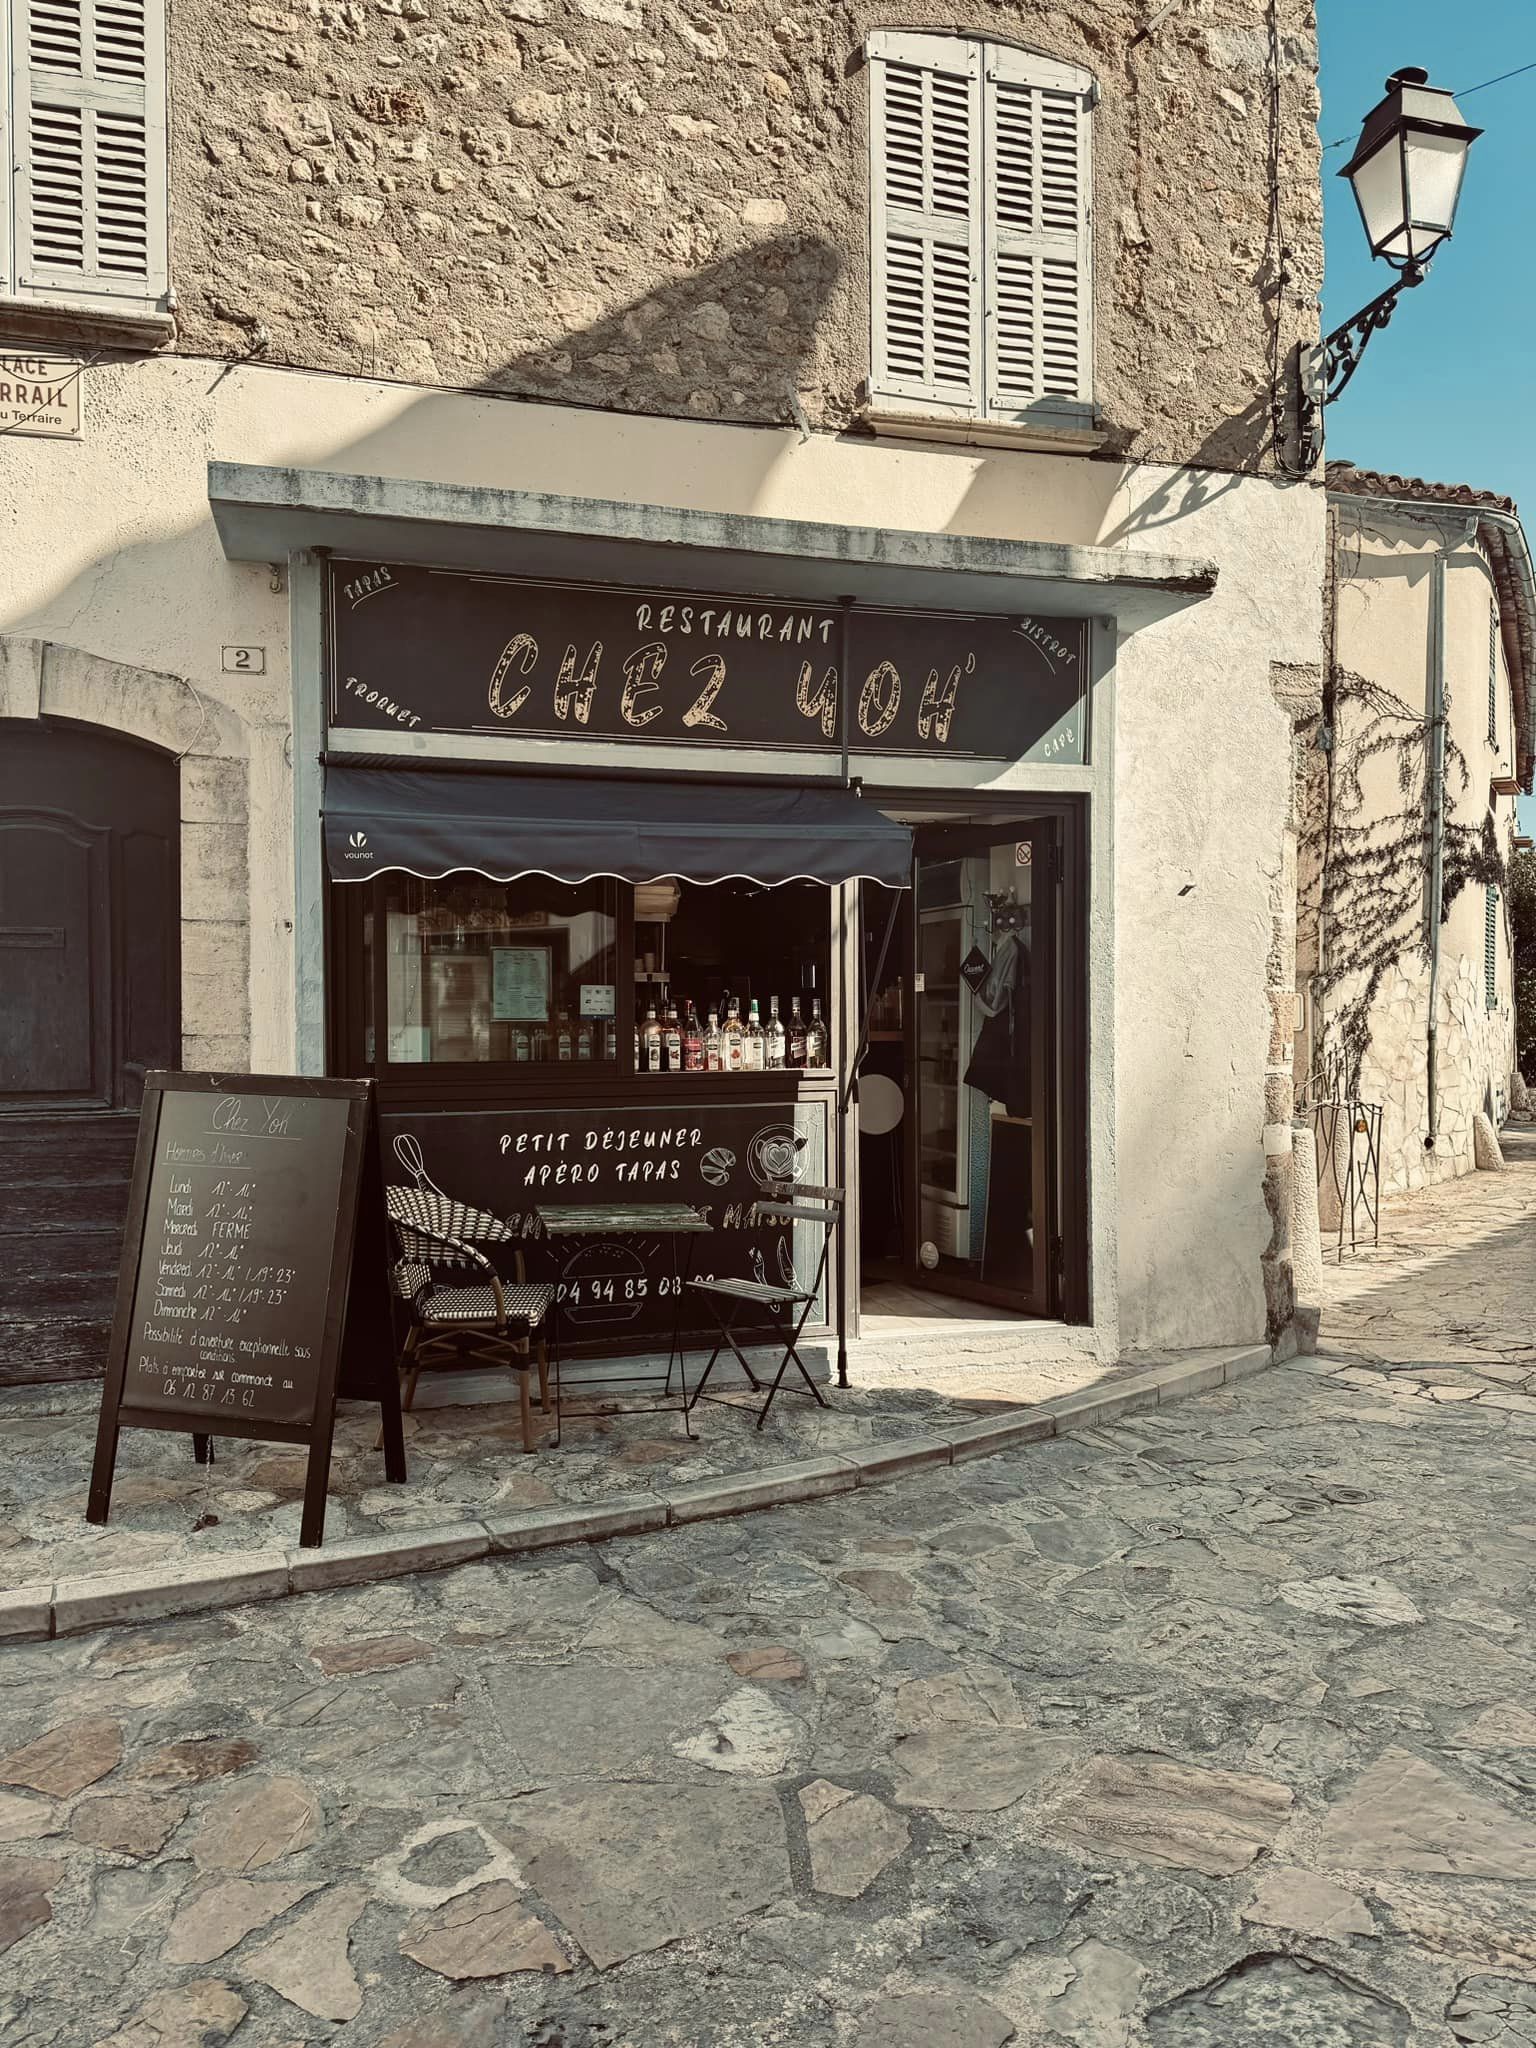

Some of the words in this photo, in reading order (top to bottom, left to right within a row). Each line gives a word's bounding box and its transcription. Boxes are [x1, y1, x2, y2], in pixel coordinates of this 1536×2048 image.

[12, 410, 62, 425] Terraire
[344, 566, 392, 600] TAPAS
[636, 604, 835, 643] RESTAURANT
[1021, 617, 1076, 665] BISTROT
[236, 650, 249, 668] 2
[488, 632, 728, 732] CHEZ
[345, 677, 421, 727] TROQUET
[212, 1097, 248, 1132] Chez
[500, 1133, 570, 1154] PETIT
[584, 1127, 702, 1151] DÉJEUNER
[170, 1174, 192, 1194] Lundi
[524, 1160, 600, 1186] APÉRO
[615, 1160, 681, 1182] TAPAS
[556, 1281, 581, 1304] 04
[591, 1279, 614, 1302] 94
[625, 1278, 648, 1299] 85
[163, 1379, 177, 1396] 06
[182, 1383, 196, 1399] 12
[202, 1384, 216, 1401] 87
[242, 1389, 255, 1407] 62
